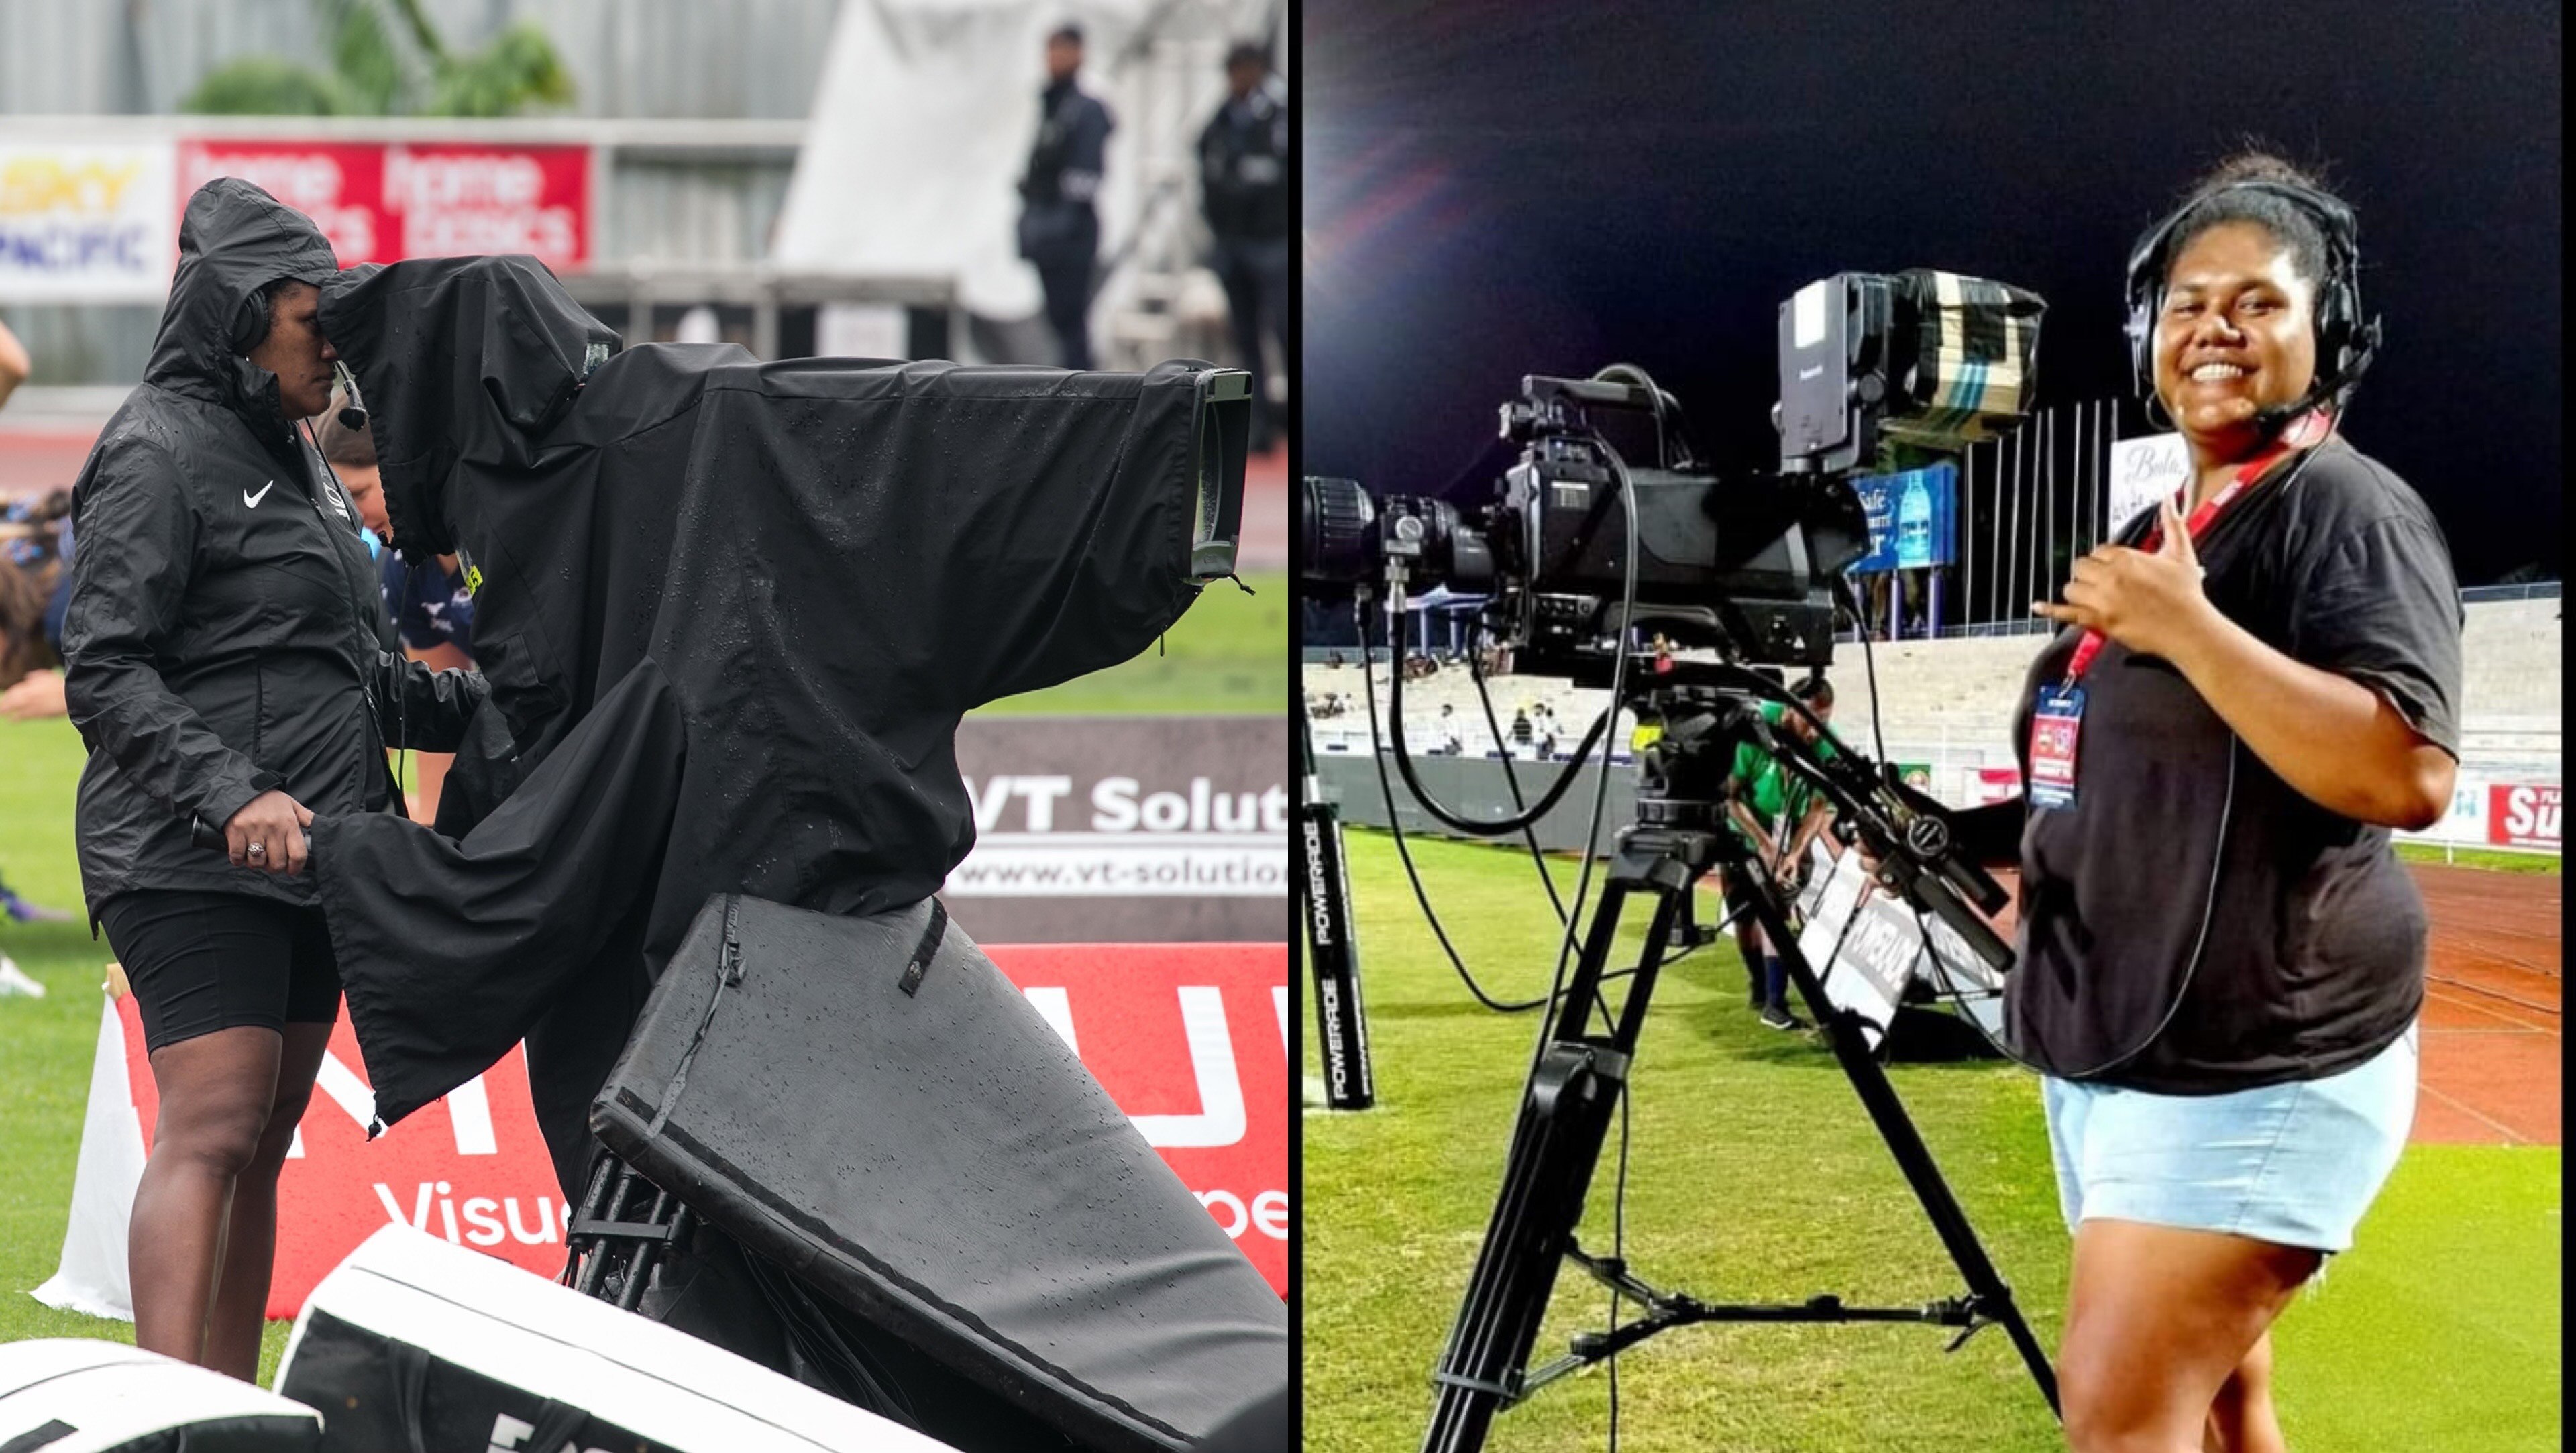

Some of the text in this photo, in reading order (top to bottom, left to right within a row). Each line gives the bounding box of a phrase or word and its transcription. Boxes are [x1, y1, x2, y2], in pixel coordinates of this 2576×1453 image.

[383, 136, 545, 215] home
[961, 775, 1072, 832] VT
[1322, 977, 1350, 1101] POWERADE
[372, 1180, 572, 1246] Visu
